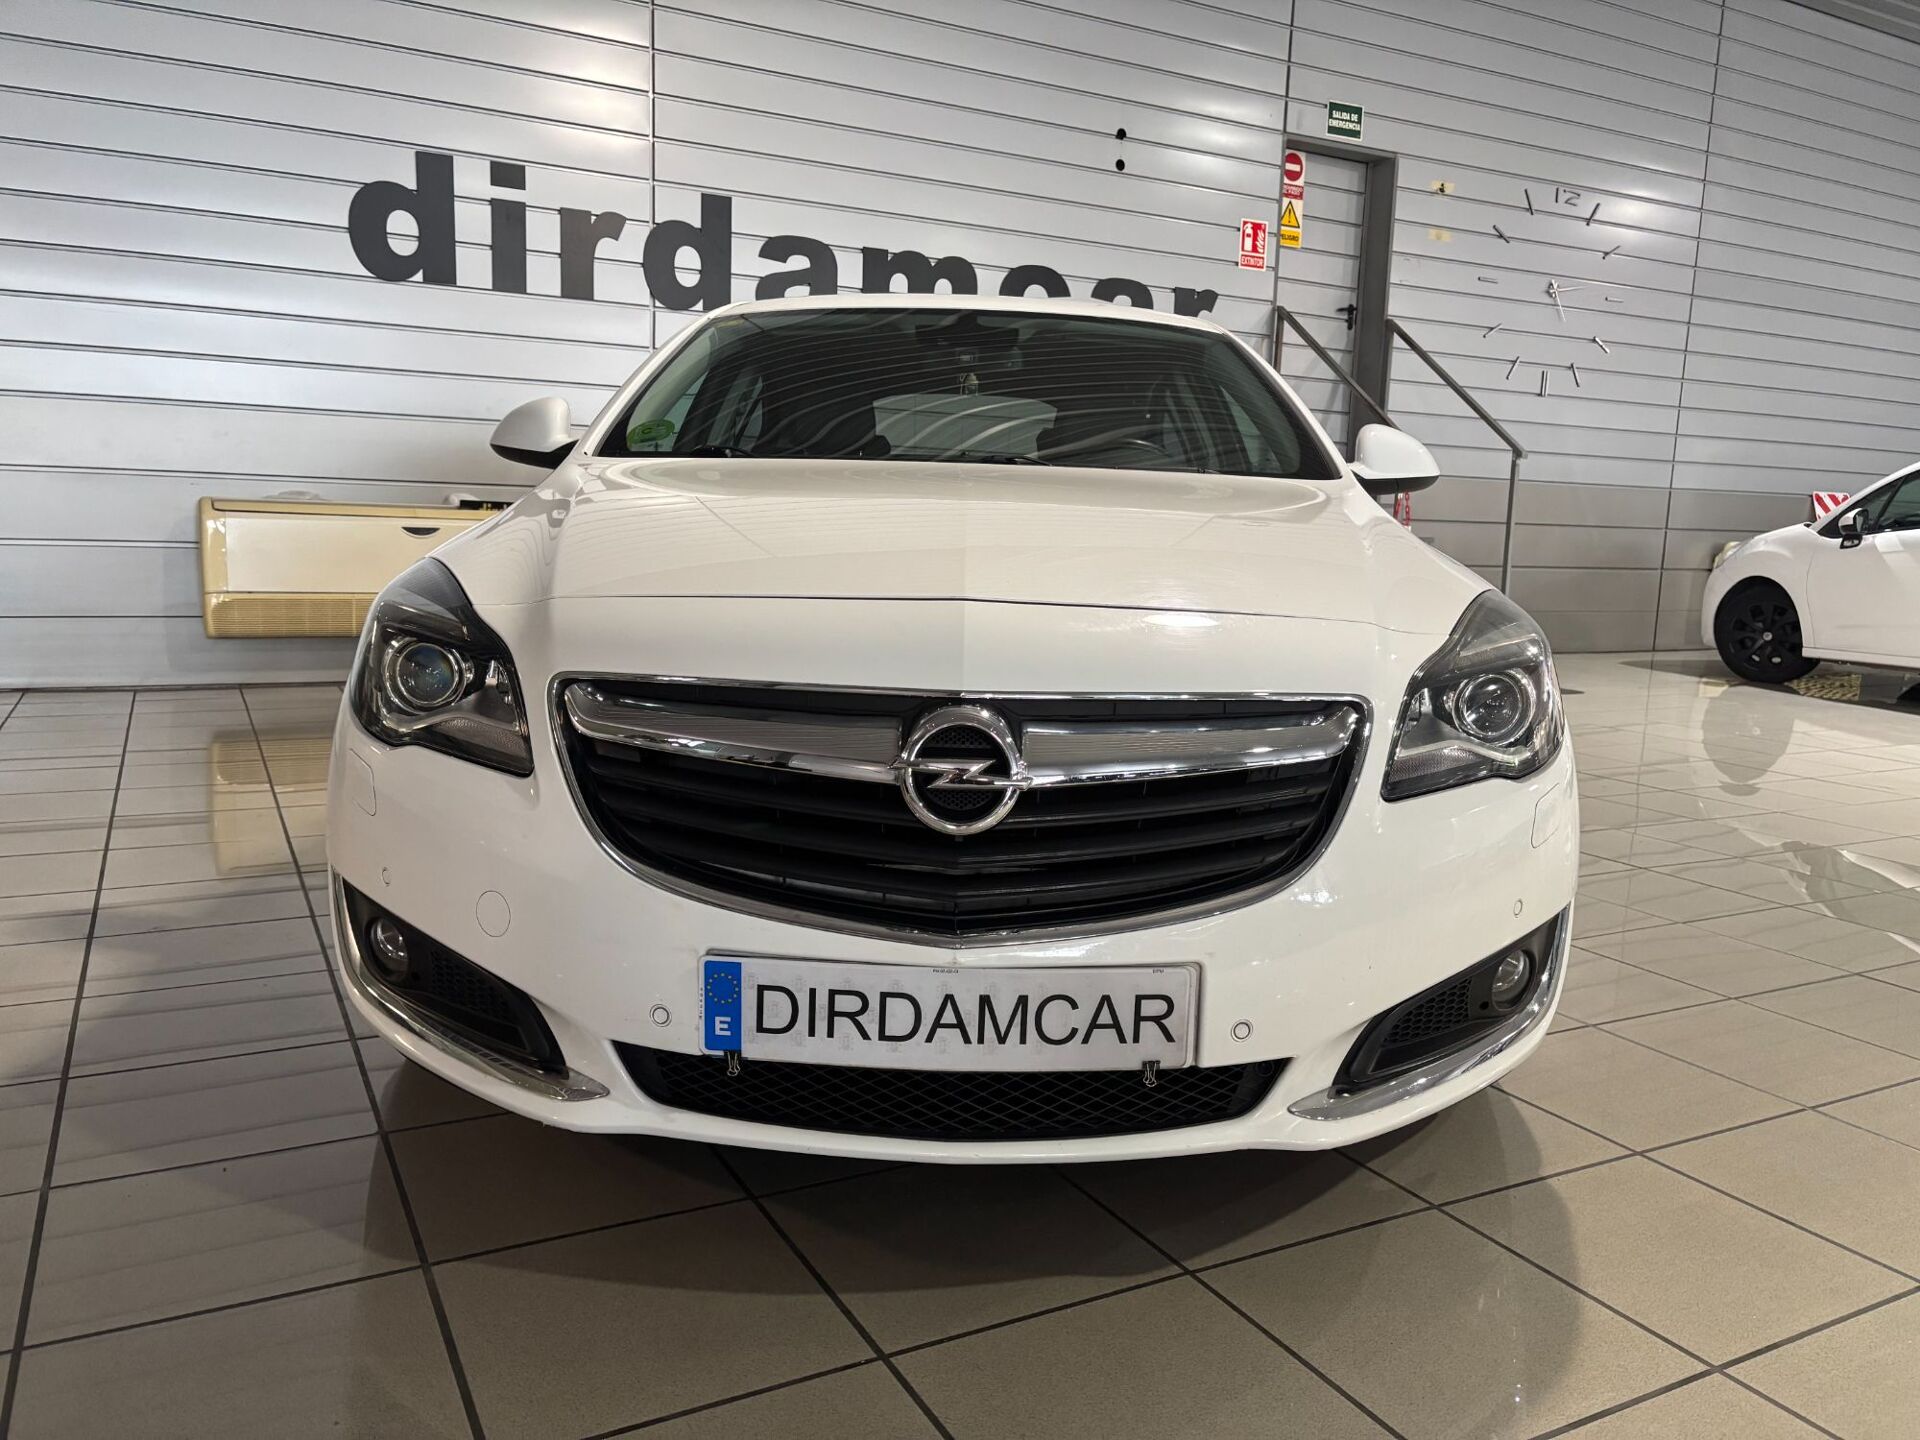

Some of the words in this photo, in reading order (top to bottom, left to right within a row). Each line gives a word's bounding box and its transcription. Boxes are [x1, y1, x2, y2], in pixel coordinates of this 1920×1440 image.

[1281, 234, 1299, 242] ELIGRO
[755, 984, 1176, 1045] DIRDAMCAR
[714, 1016, 732, 1036] E
